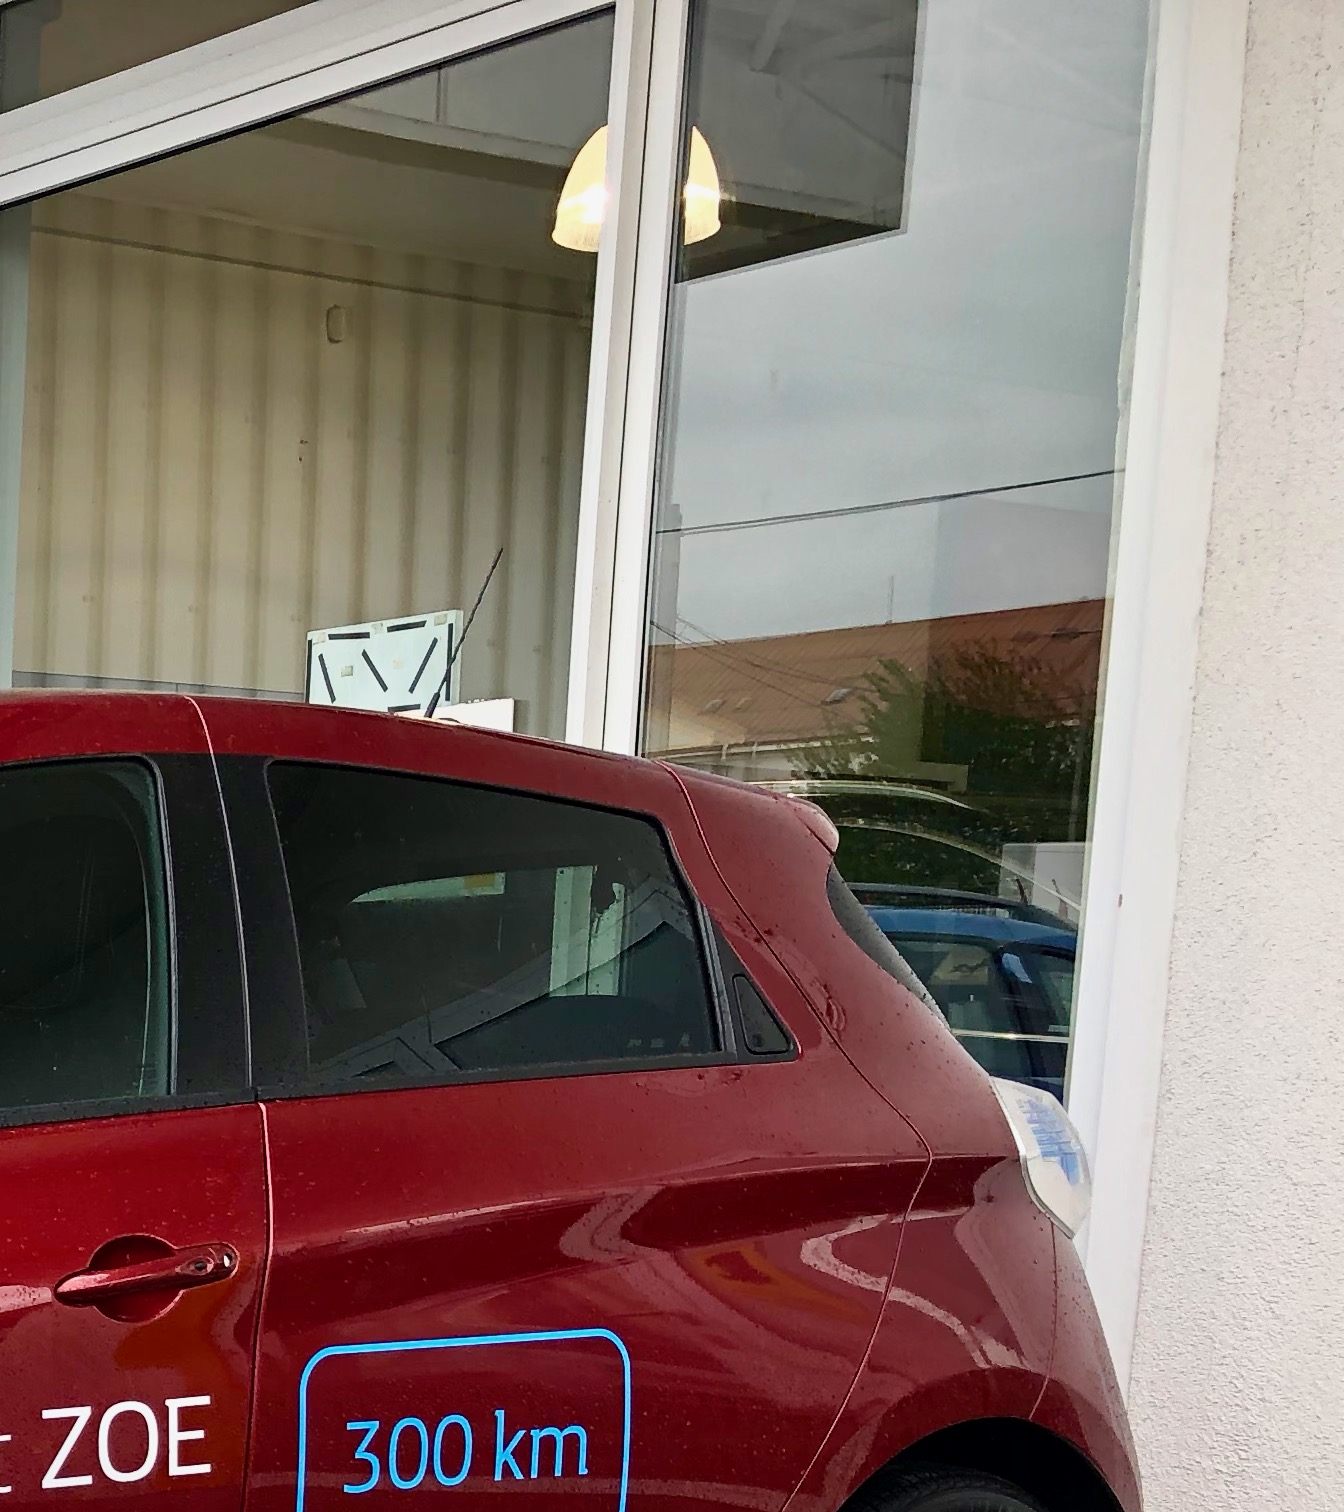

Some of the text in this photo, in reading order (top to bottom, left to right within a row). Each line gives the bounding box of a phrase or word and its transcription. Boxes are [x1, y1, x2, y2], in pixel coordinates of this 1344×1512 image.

[40, 1395, 212, 1490] ZOE
[343, 1408, 589, 1494] 300 km
